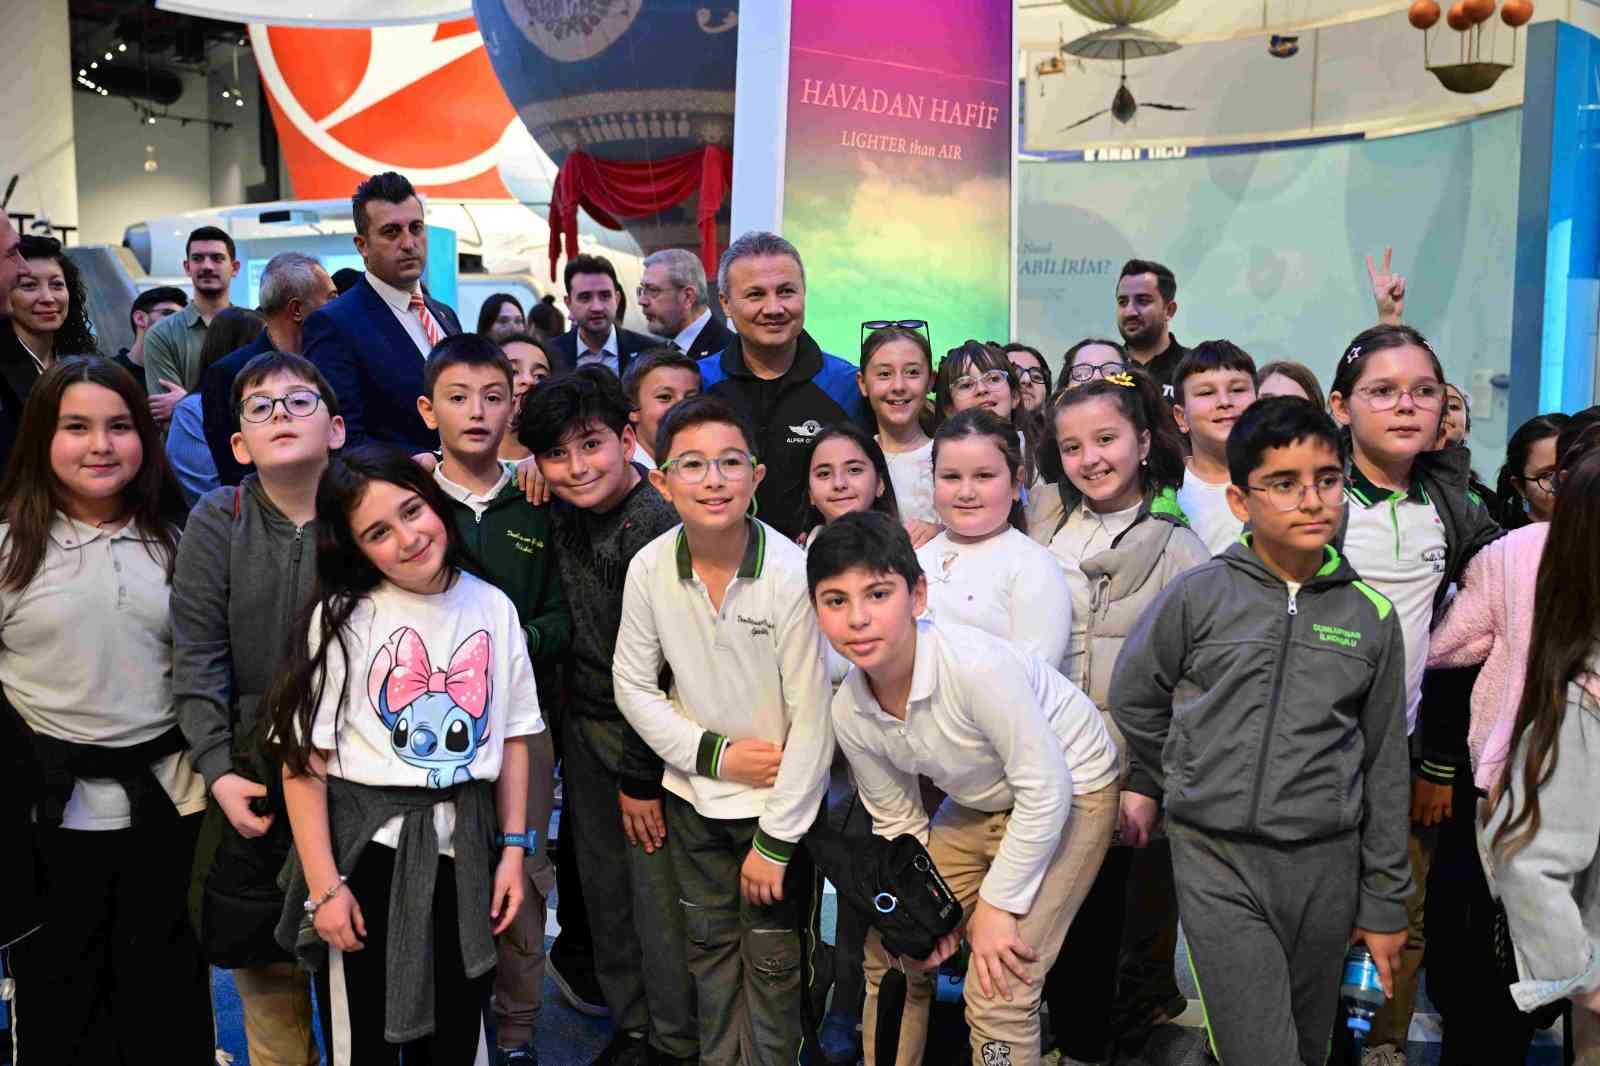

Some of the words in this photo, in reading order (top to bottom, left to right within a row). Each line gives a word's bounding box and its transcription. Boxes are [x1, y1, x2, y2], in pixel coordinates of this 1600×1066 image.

[800, 78, 924, 120] HAVADAN
[929, 97, 1000, 130] HAFİF
[840, 130, 906, 153] LIGHTER
[909, 139, 936, 158] than
[937, 143, 963, 160] AIR
